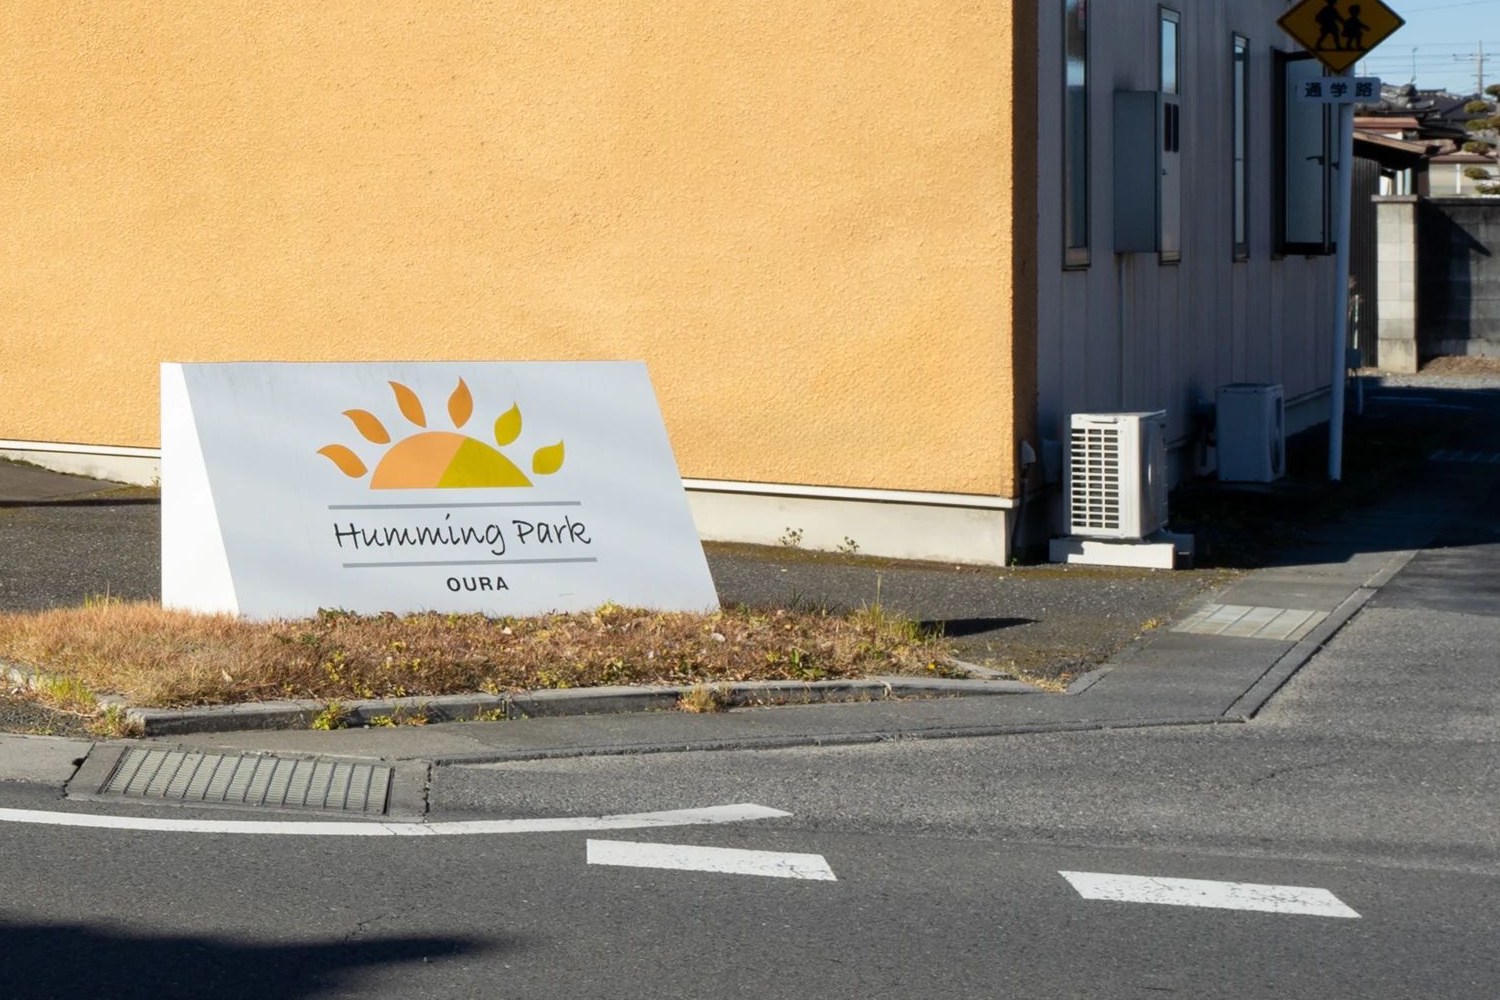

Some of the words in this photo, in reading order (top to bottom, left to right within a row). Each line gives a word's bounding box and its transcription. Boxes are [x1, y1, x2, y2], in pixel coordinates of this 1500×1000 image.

[1304, 82, 1373, 98] 通学路
[334, 513, 506, 555] Humming
[512, 515, 592, 544] Park
[446, 576, 509, 592] OURA
